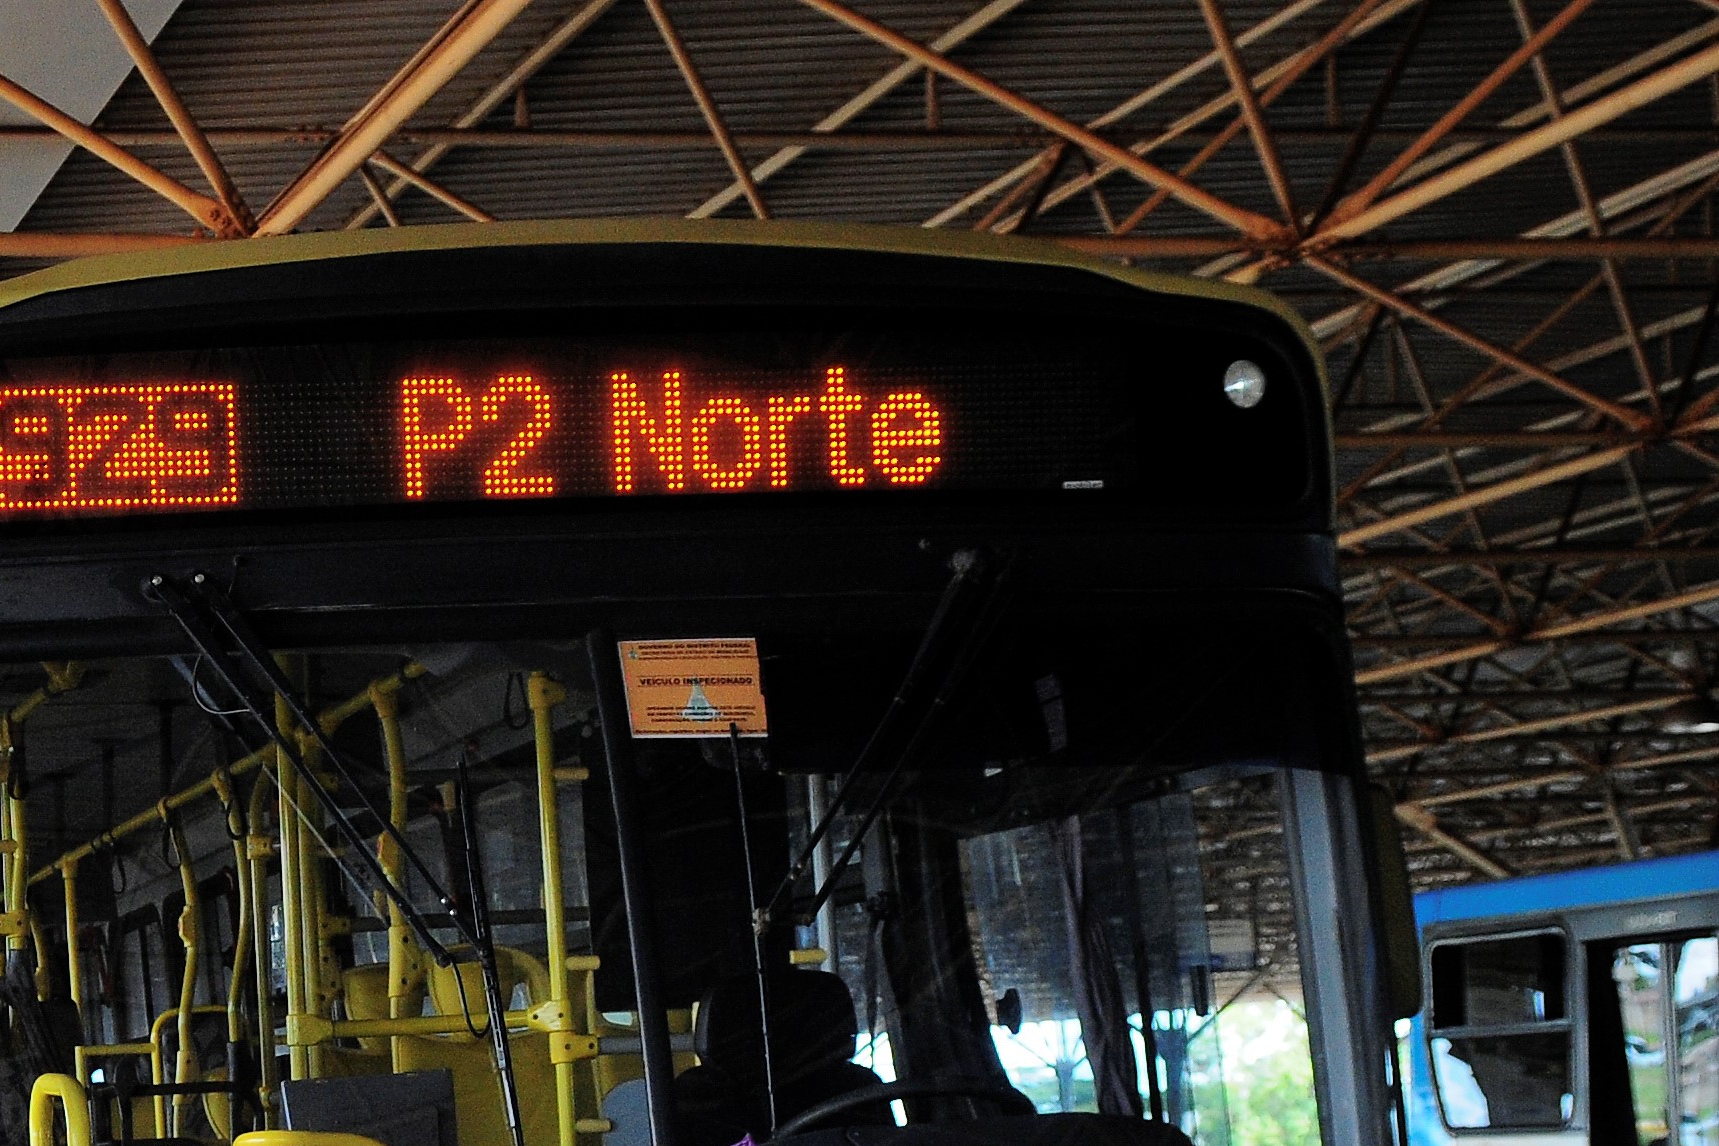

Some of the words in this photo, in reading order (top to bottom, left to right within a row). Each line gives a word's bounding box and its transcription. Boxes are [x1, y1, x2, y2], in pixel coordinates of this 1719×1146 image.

[402, 375, 554, 498] P2
[611, 366, 941, 492] Norte
[683, 676, 752, 686] INSPECIONADO
